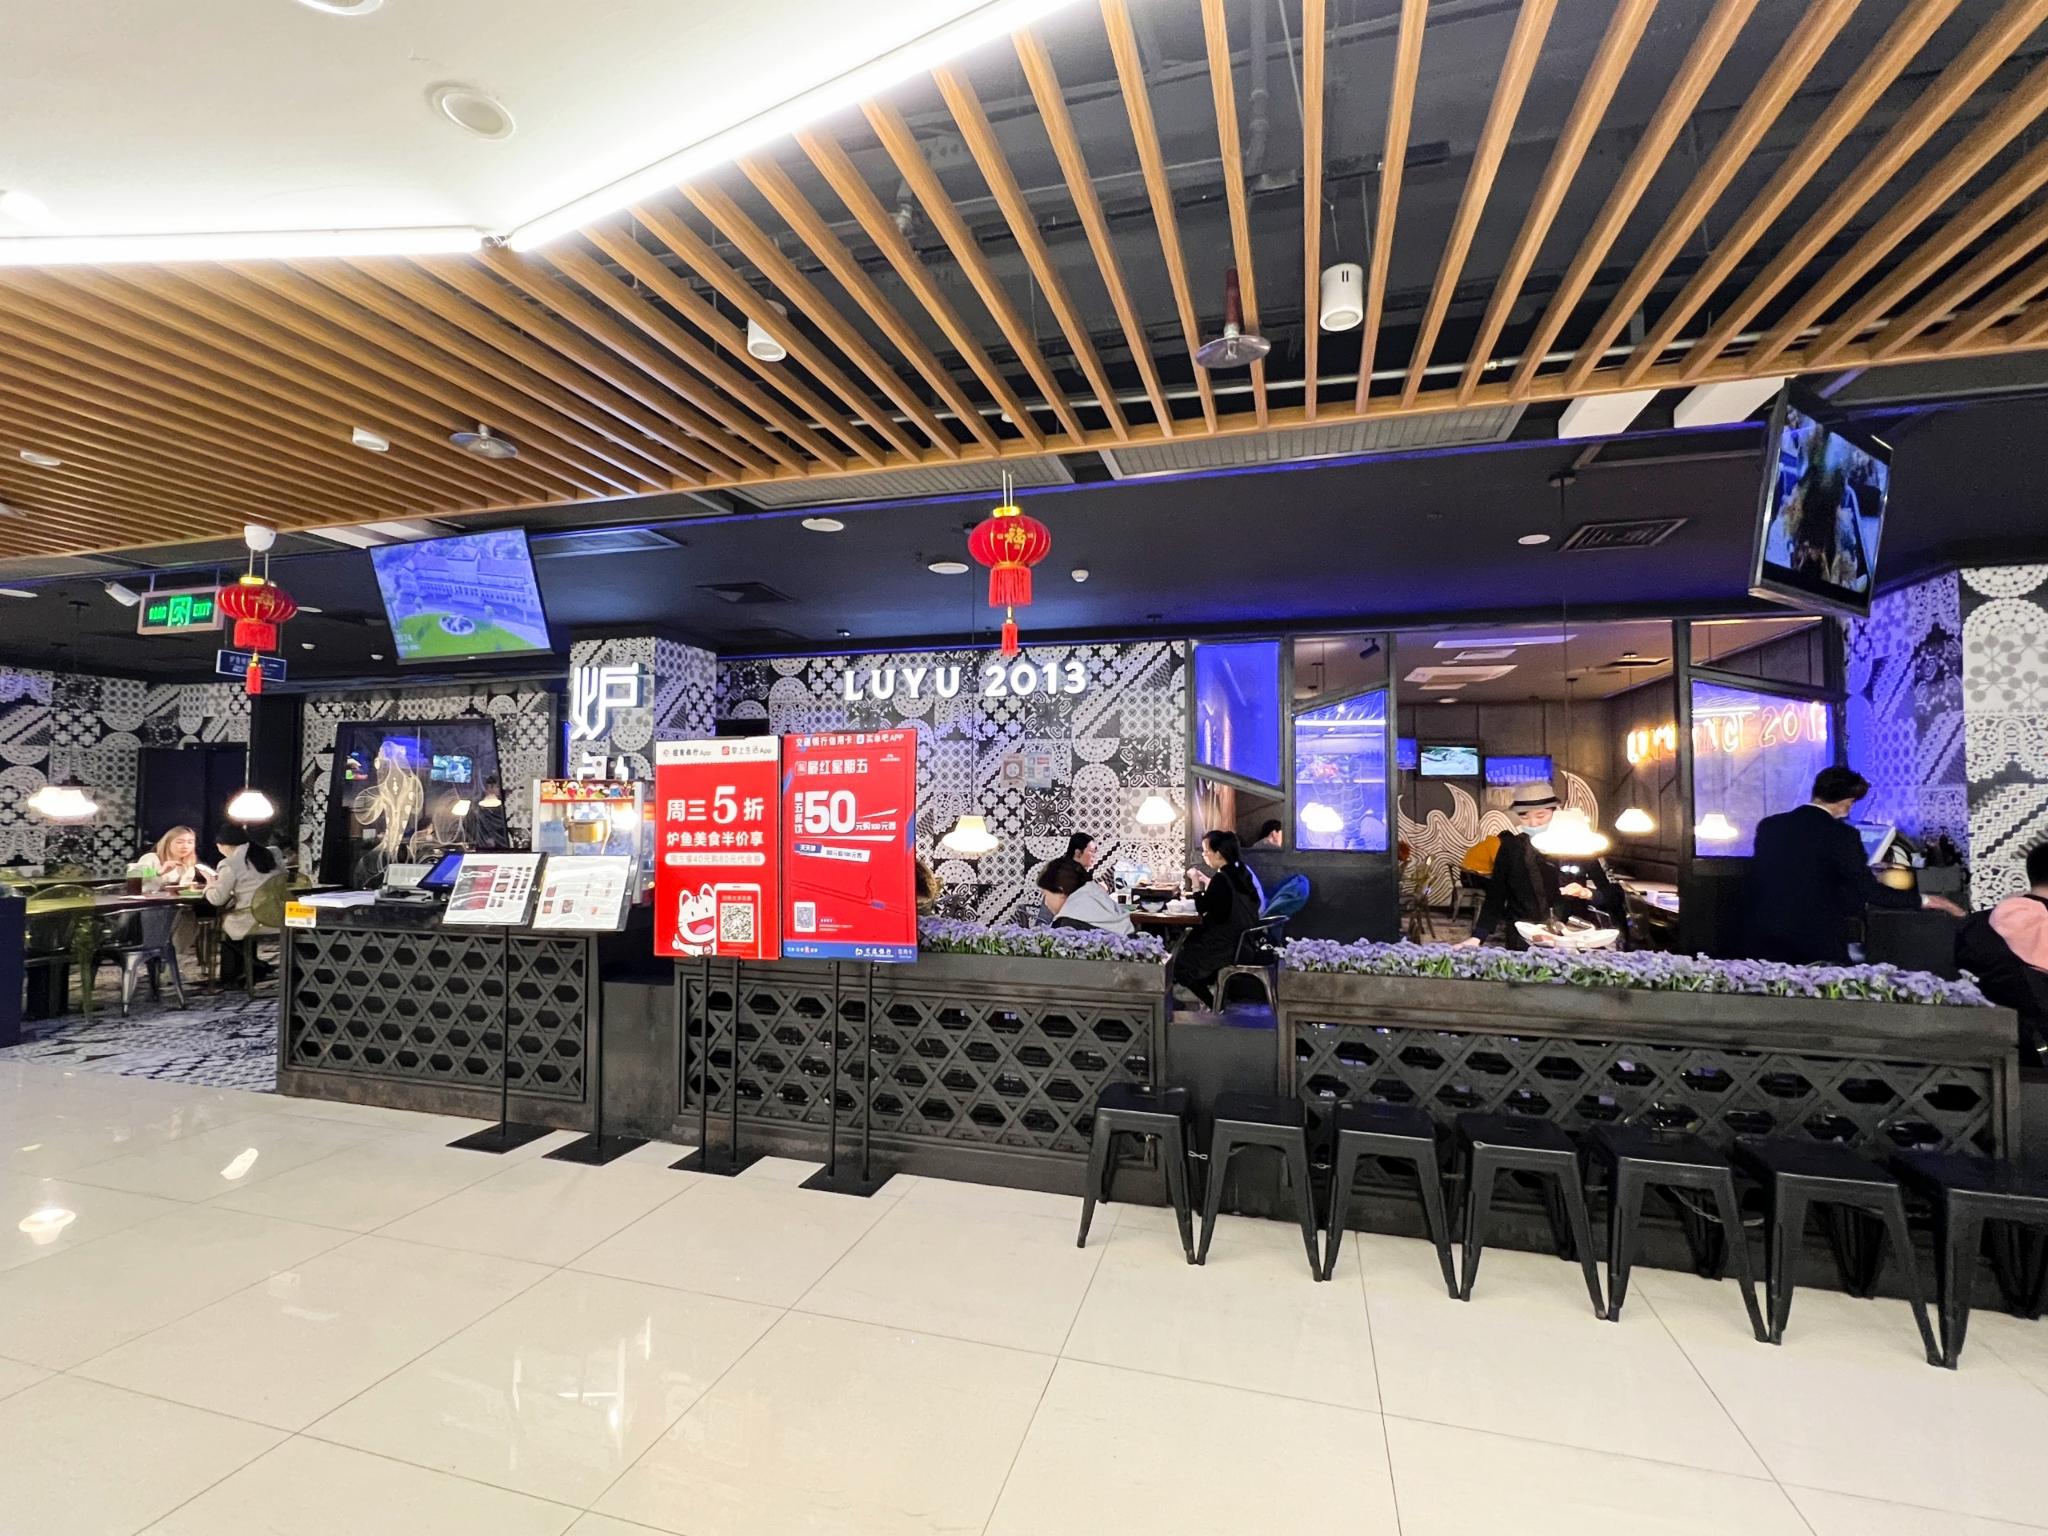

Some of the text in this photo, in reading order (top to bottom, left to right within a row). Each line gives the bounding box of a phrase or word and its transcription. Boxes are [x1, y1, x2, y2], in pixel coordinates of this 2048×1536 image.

[192, 602, 212, 617] EXIT
[843, 662, 1087, 701] LUYU 2013
[804, 790, 857, 834] 50
[666, 830, 764, 847] 炉鱼美食半价享
